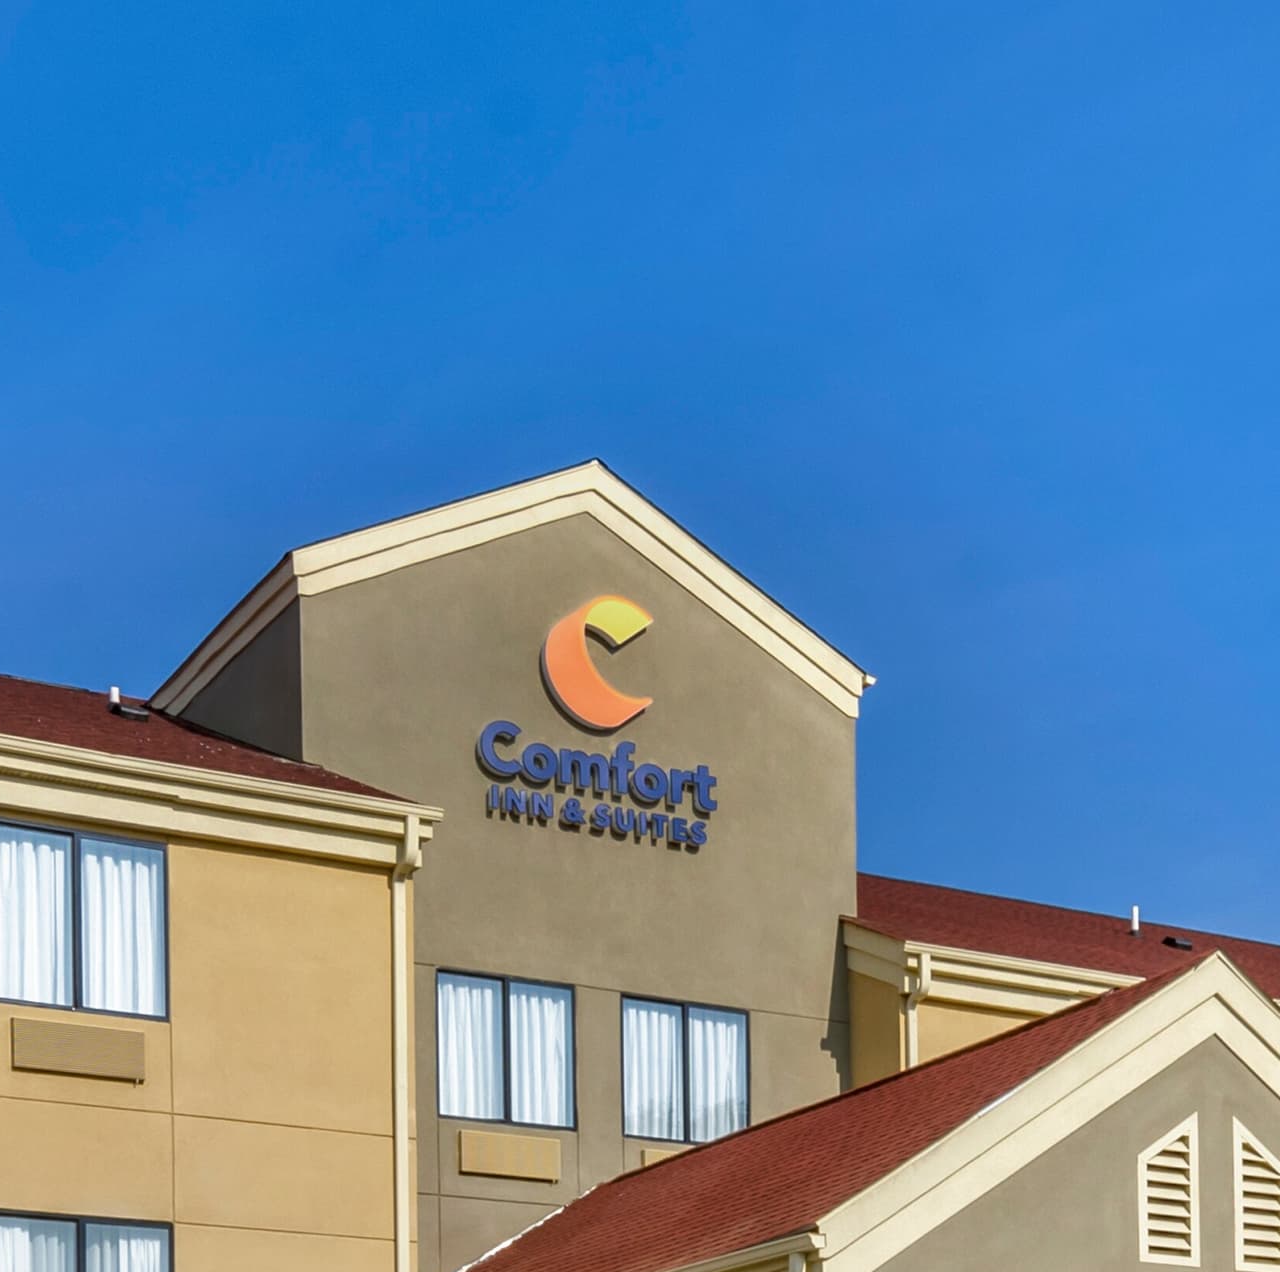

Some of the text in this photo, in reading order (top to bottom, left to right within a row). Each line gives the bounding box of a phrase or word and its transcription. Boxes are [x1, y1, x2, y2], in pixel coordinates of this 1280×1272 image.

[477, 719, 718, 812] Comfort
[487, 783, 708, 846] INN & SUITES
